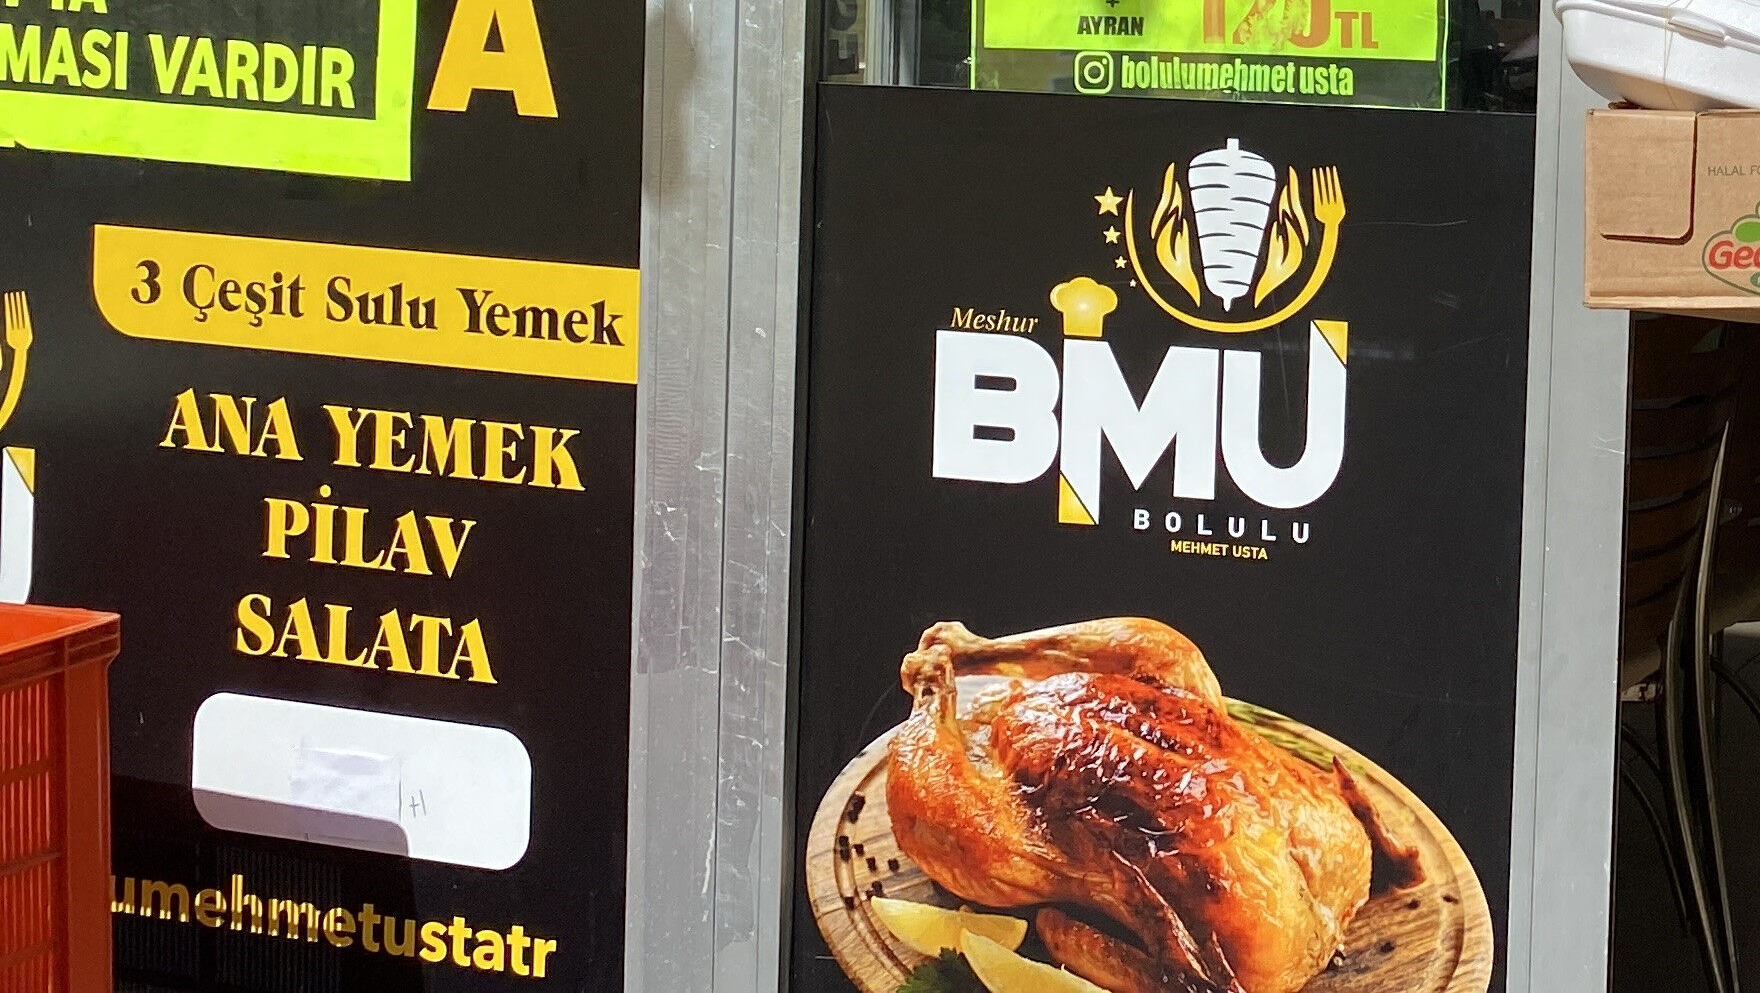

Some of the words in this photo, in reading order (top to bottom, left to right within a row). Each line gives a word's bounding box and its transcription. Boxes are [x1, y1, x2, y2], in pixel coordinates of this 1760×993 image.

[1076, 15, 1145, 38] AYRAN
[148, 32, 356, 110] VARDIR
[1707, 165, 1746, 177] HALAL
[130, 259, 162, 306] 3
[183, 263, 306, 329] Çeşit
[325, 275, 438, 333] Sulu
[456, 286, 626, 350] Yemek
[949, 306, 1039, 334] Meshur
[158, 386, 305, 463] ANA
[322, 403, 587, 492] YEMEK
[262, 484, 478, 581] PİLAV
[1133, 508, 1310, 544] BOLULU
[1170, 539, 1229, 557] MEHMET
[1232, 545, 1269, 561] USTA
[234, 592, 498, 686] SALATA
